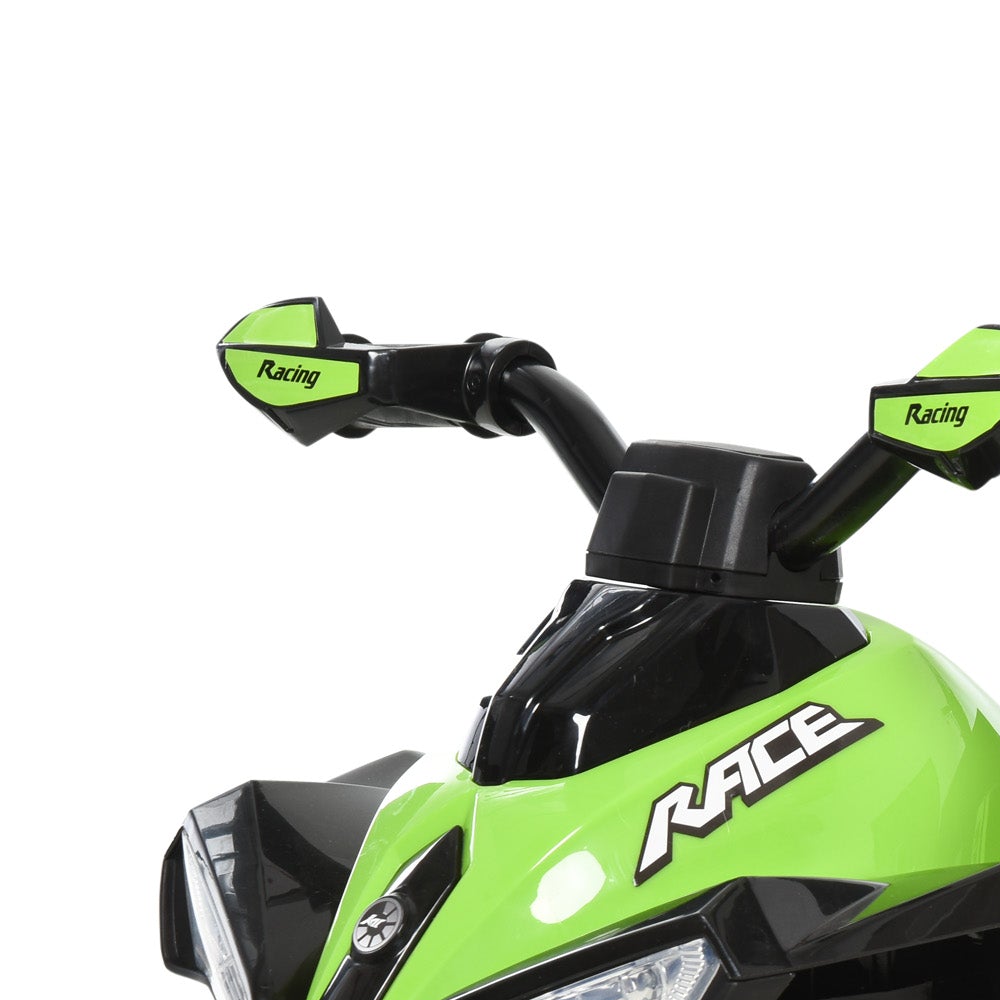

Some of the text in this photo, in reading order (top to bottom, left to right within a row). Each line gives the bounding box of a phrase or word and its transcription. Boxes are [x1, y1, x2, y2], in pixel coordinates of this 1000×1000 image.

[257, 360, 321, 389] Racing
[905, 402, 970, 428] Racing
[638, 703, 868, 875] RACE
